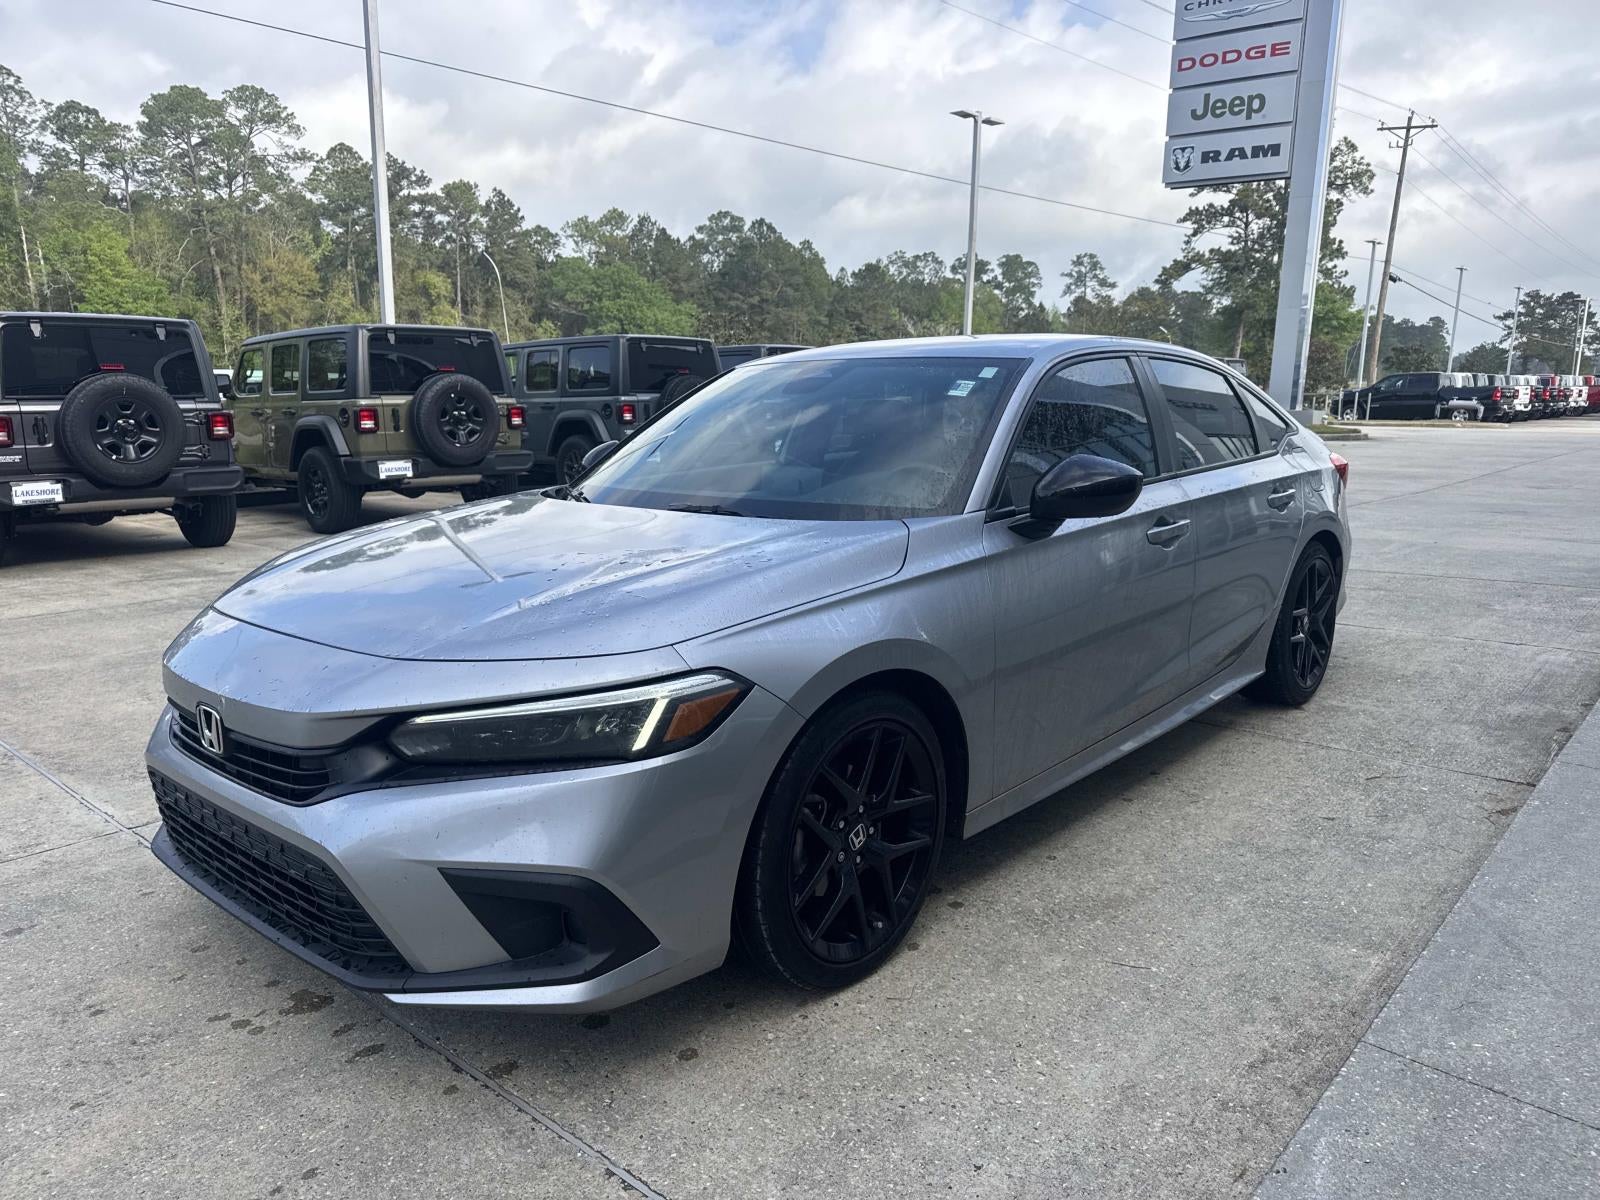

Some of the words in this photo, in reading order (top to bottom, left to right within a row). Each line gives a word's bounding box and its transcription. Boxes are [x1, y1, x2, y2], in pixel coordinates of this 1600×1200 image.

[1177, 41, 1291, 72] DODGE
[1190, 92, 1266, 121] Jeep
[1200, 143, 1281, 164] RAM
[14, 488, 61, 498] LAKESHORE
